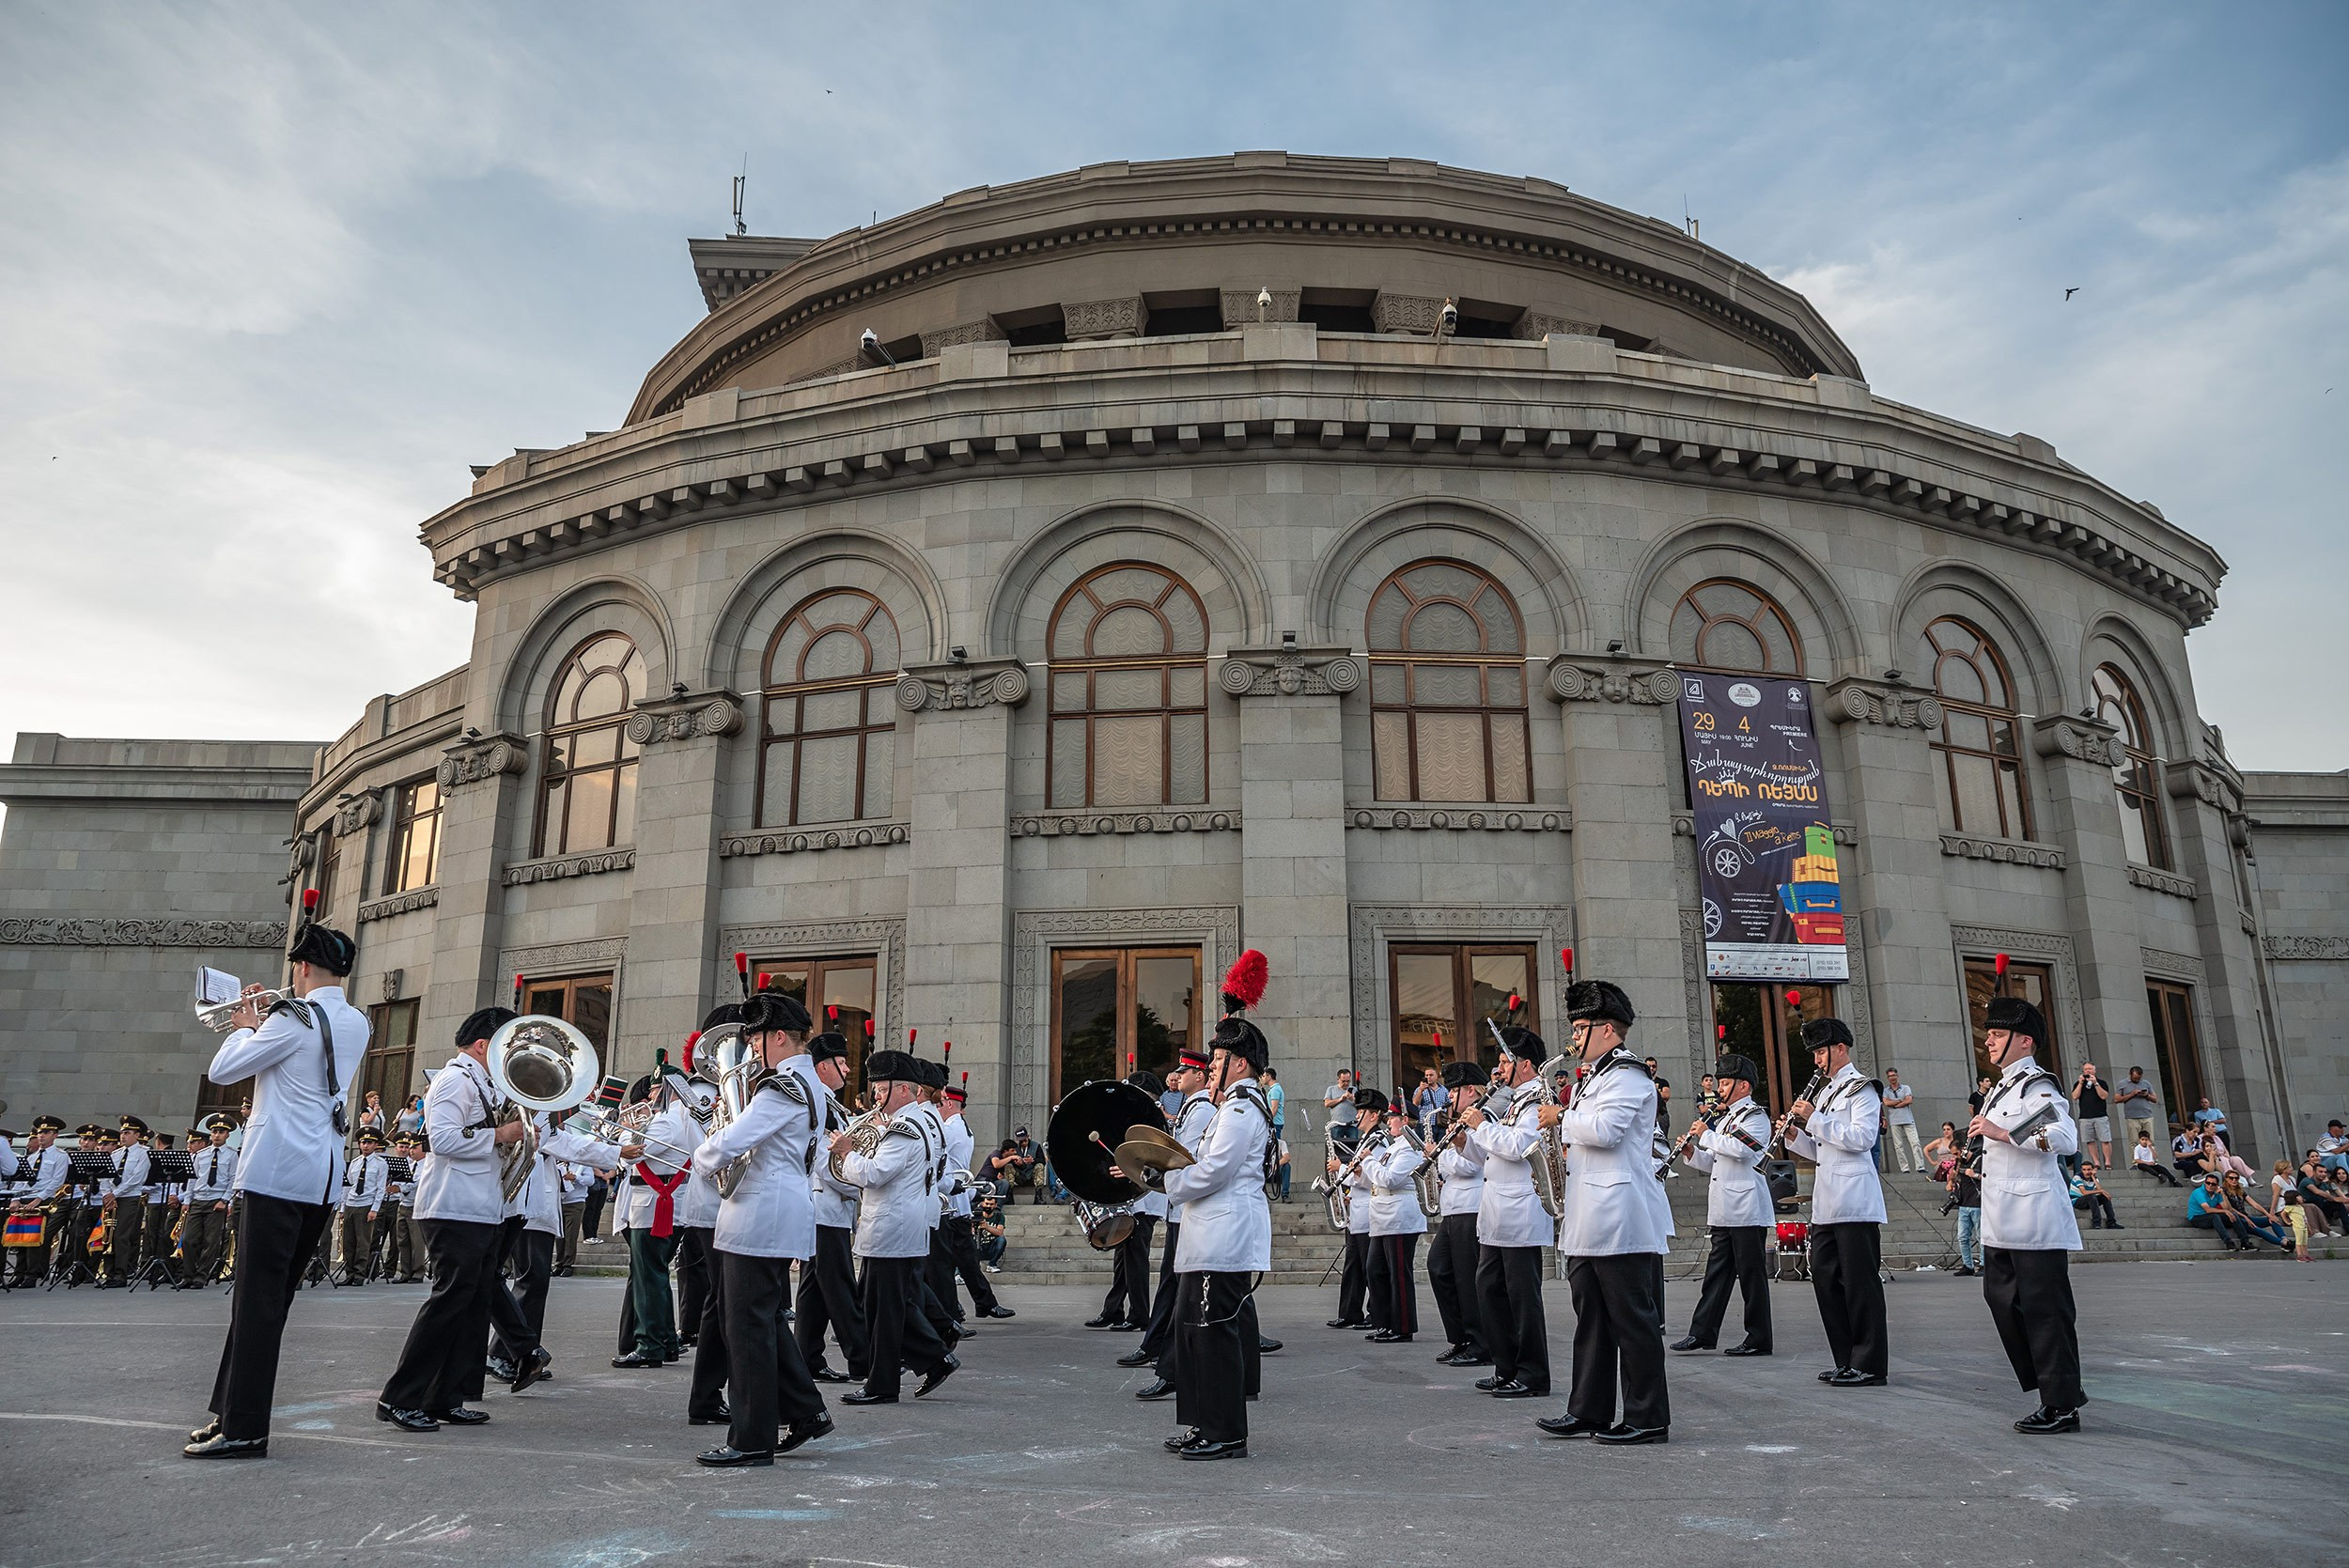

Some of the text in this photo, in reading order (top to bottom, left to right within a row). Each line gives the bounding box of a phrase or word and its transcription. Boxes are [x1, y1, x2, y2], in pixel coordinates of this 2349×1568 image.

[1692, 711, 1715, 731] 29
[1738, 715, 1750, 734] 4
[1694, 731, 1717, 739] ՄԱՅԻՍ
[1698, 779, 1818, 802] ԴԵՊԻ ՌԵՅՄՍ
